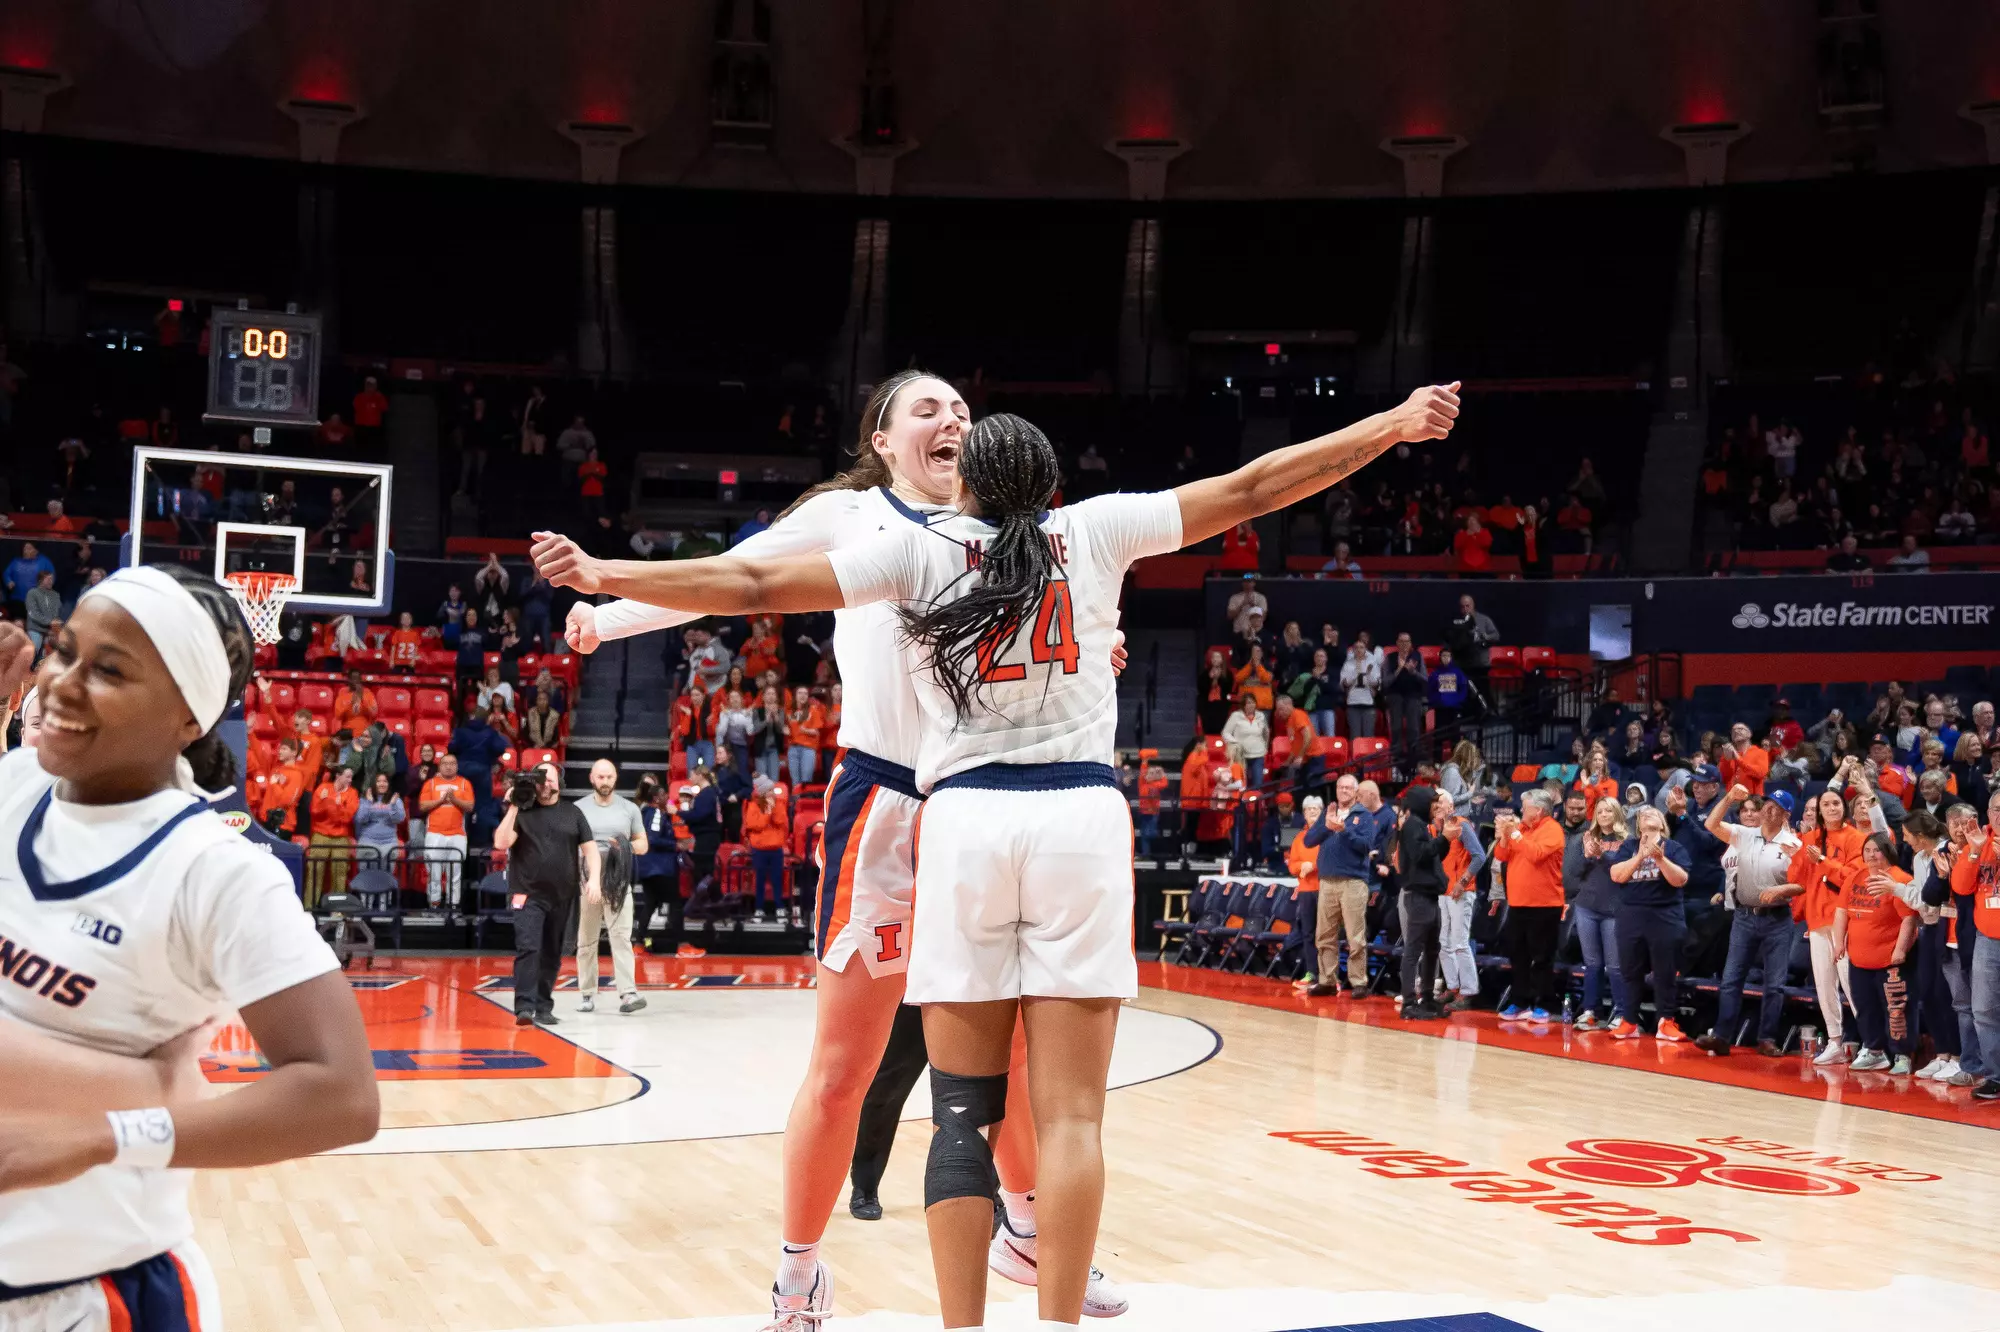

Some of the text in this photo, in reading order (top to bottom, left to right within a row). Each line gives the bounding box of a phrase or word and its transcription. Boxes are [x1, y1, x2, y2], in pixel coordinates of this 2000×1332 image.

[1904, 605, 1990, 626] CENTER
[874, 922, 902, 963] I
[1695, 1135, 1943, 1182] CENTER
